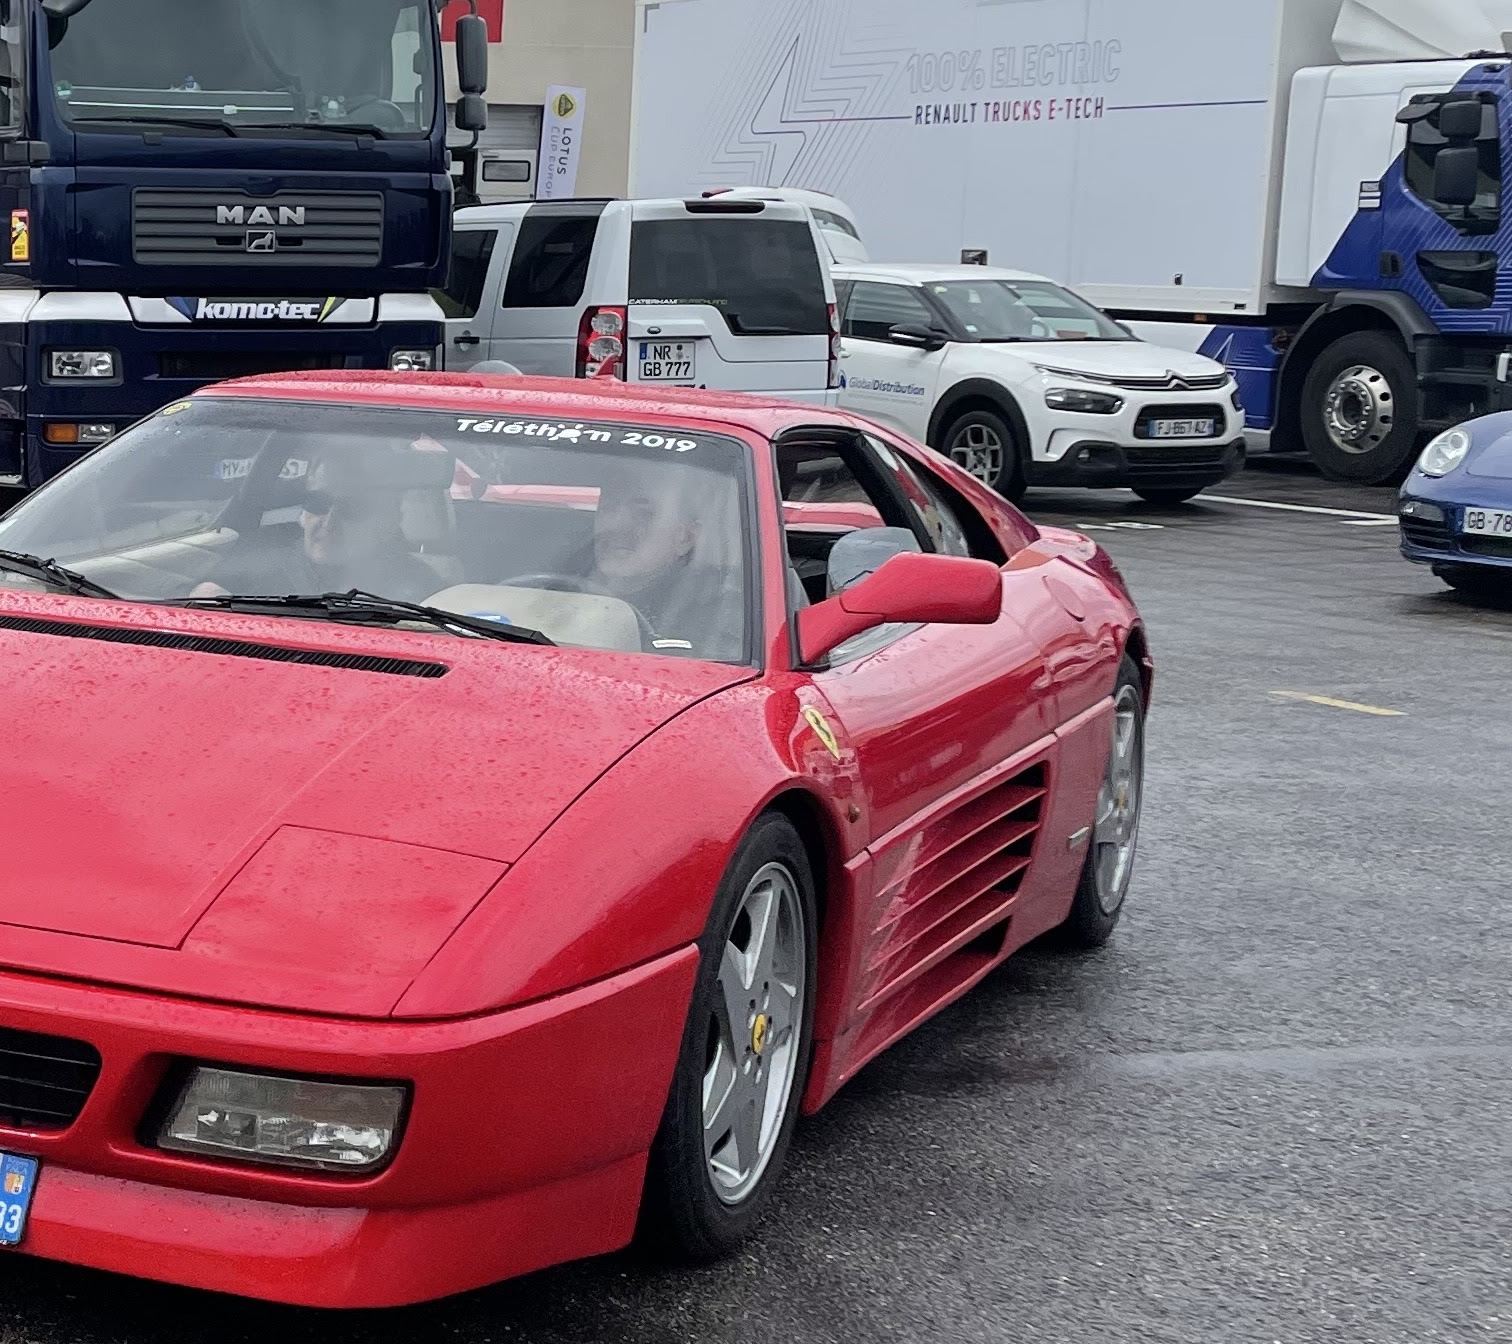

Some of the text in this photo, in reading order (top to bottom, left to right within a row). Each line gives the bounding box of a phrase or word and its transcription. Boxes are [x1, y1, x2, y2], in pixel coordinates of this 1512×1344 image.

[906, 39, 1122, 94] 100% ELECTRIC
[914, 97, 1105, 125] RENAULT TRUCKS E-TECH
[556, 127, 573, 175] LOTUS
[216, 205, 305, 225] MAN
[195, 297, 320, 319] komo-tec
[653, 345, 672, 361] NR
[643, 361, 691, 377] GB 777
[620, 432, 697, 453] 2019
